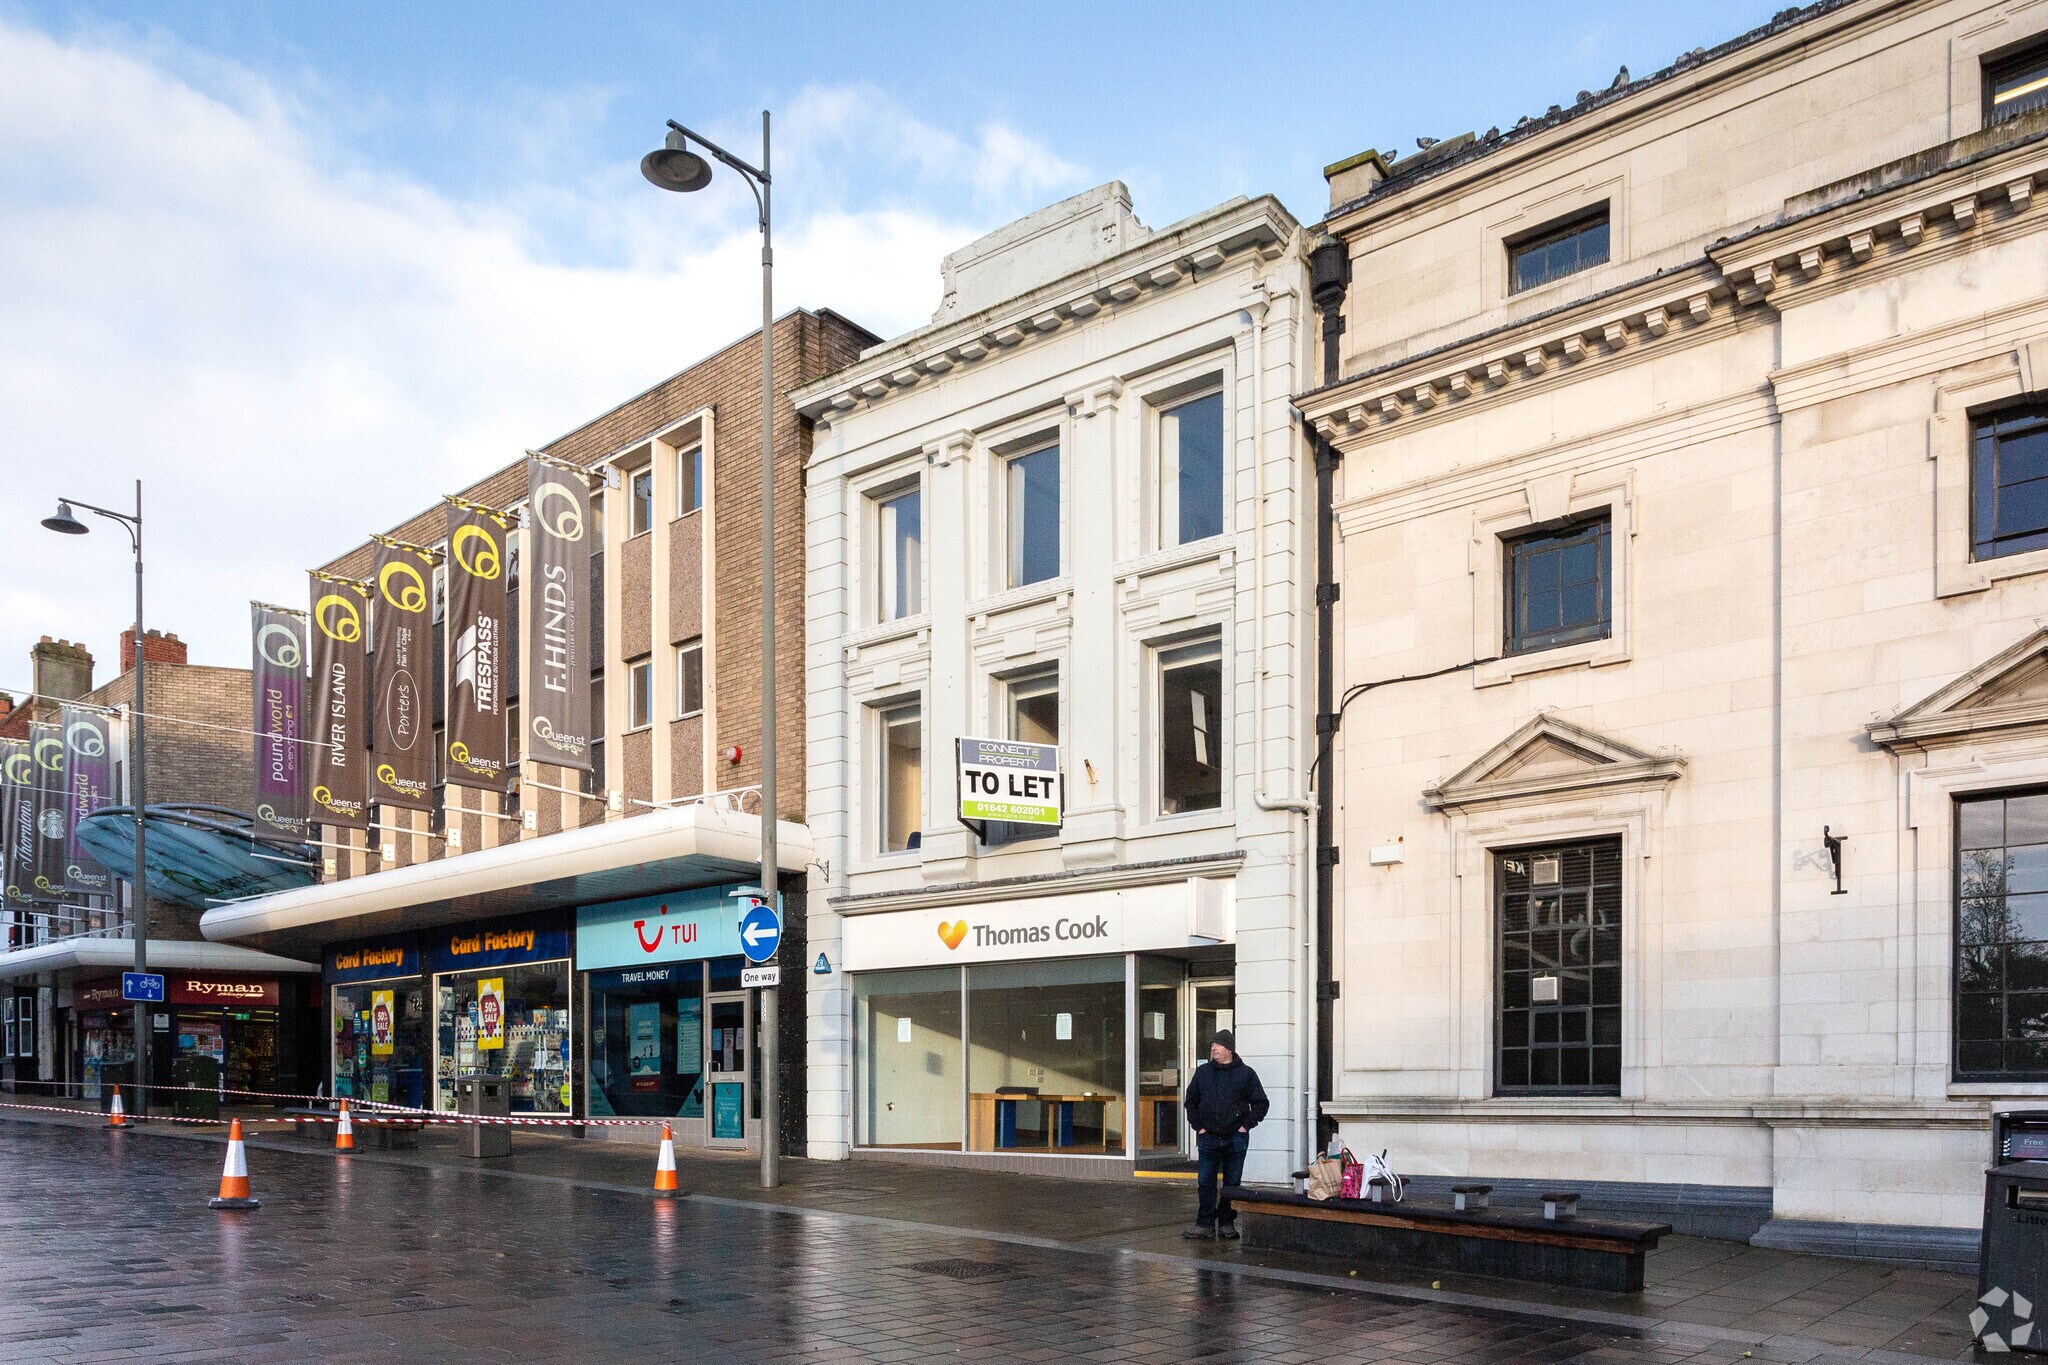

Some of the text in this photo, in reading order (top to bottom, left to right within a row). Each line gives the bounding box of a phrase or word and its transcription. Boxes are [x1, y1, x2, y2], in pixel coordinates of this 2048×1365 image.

[544, 564, 567, 693] F.HINDS
[478, 615, 492, 713] TRESPASS
[332, 663, 346, 767] RIVER ISLAND
[267, 689, 288, 782] poundworld
[287, 720, 295, 771] everything
[979, 742, 1032, 755] CONNECT
[979, 755, 1039, 768] PROPERTY
[965, 770, 1054, 799] TO LET
[75, 773, 89, 824] ndworld
[977, 802, 1045, 816] 01642 602001
[14, 800, 32, 872] Thorntons
[672, 923, 697, 944] TUI
[973, 915, 1108, 947] Thomas Cook
[451, 929, 535, 956] Card Factory
[335, 948, 403, 969] Card Factory
[622, 970, 670, 983] TRAVEL MONEY
[744, 972, 776, 983] One way
[92, 987, 119, 1002] Ryman
[186, 981, 264, 995] Ryman
[377, 1022, 388, 1031] SALE
[485, 1013, 497, 1023] SALE
